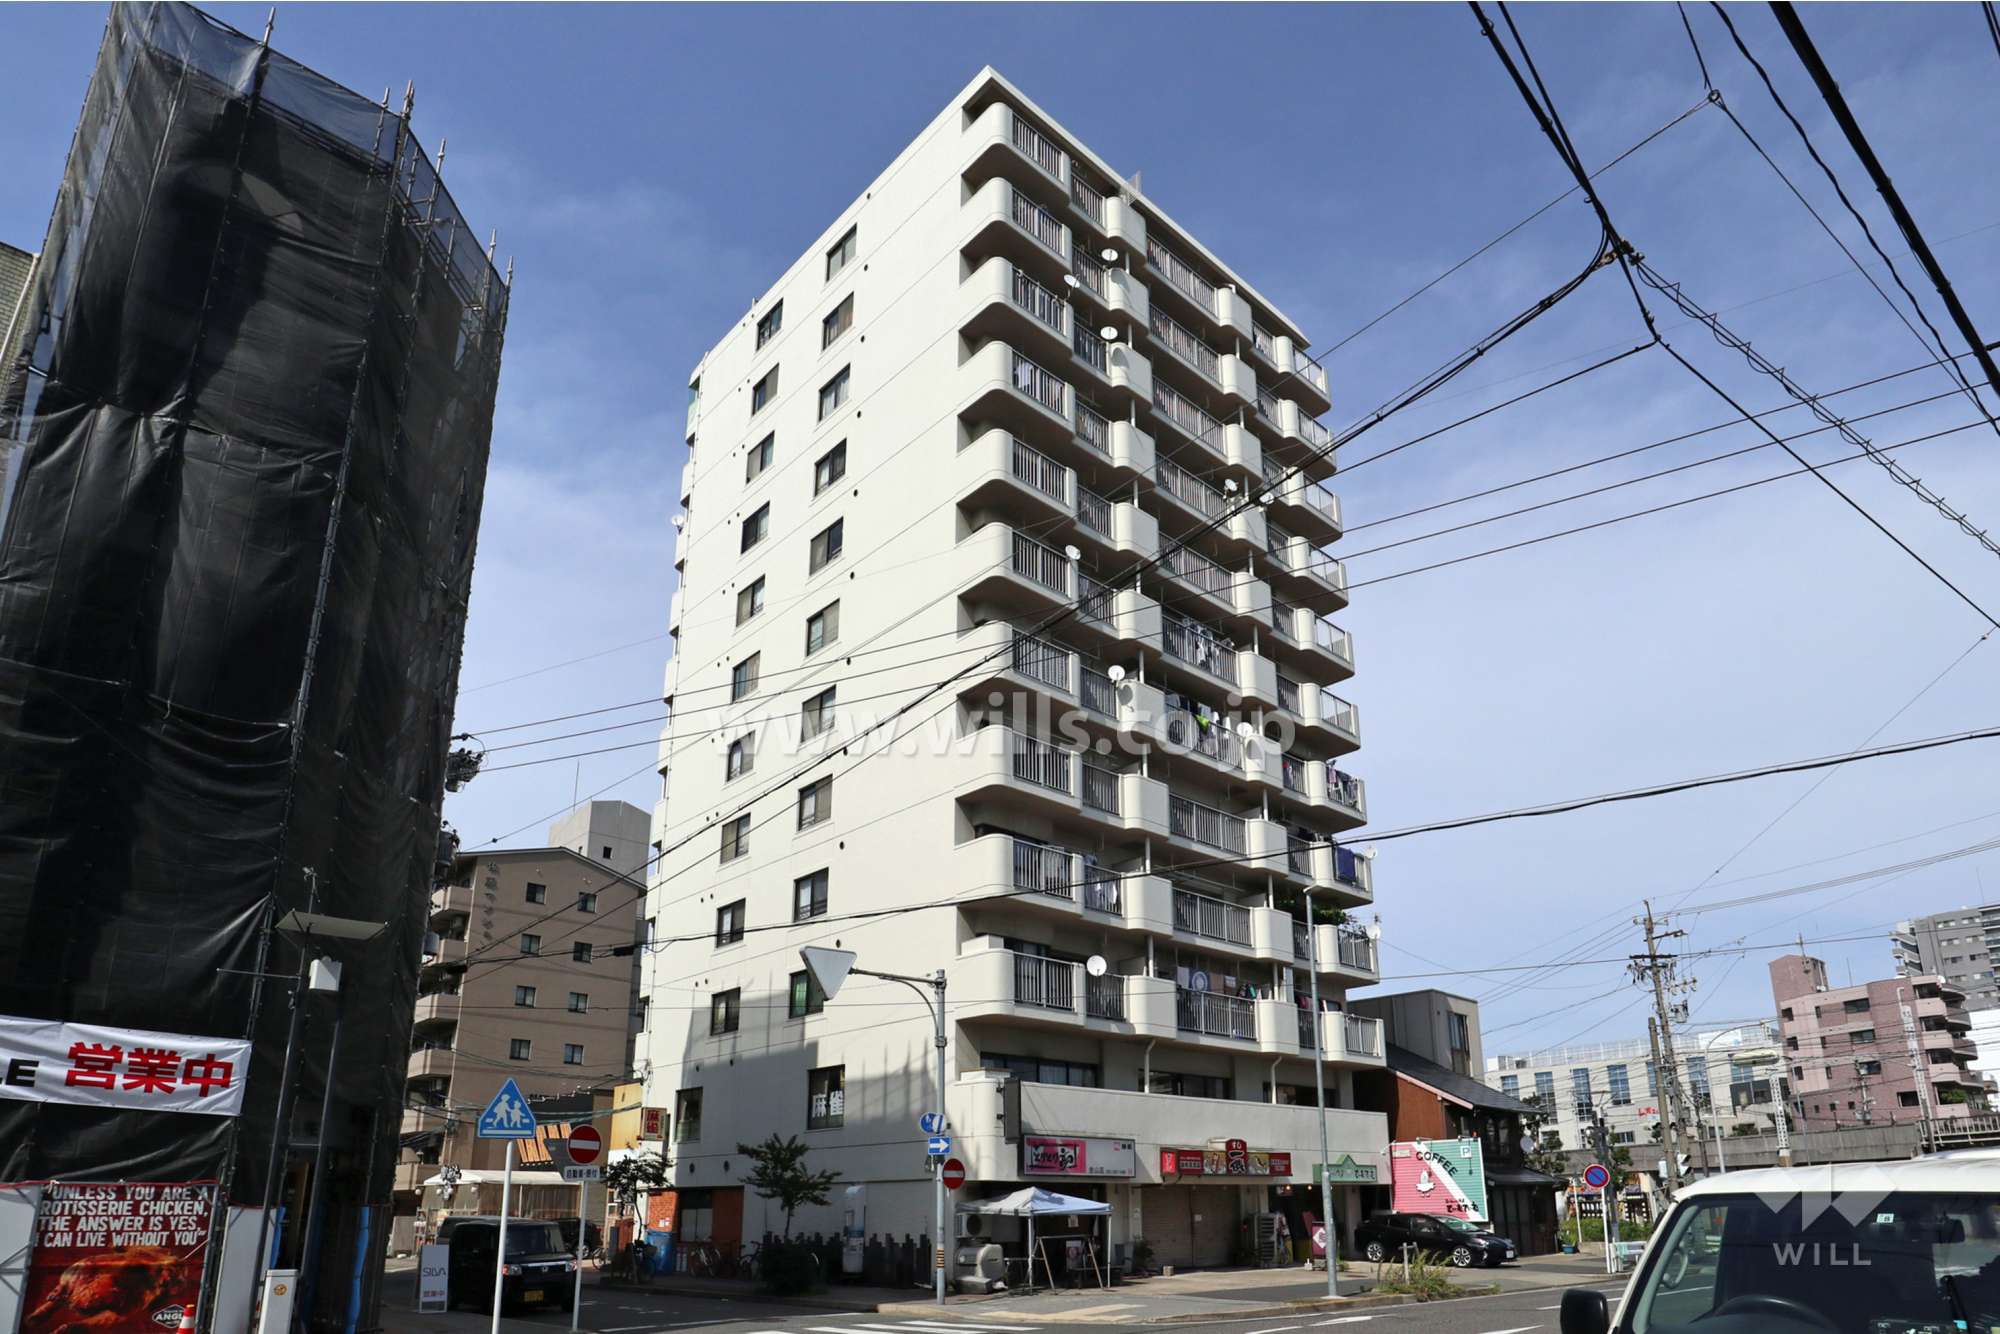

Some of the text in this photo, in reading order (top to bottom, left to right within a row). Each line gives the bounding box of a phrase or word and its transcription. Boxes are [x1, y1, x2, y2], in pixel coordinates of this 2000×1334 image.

[0, 1041, 234, 1098] E 営業中
[1462, 1147, 1471, 1157] P
[1416, 1151, 1459, 1177] COFFEE
[125, 1186, 156, 1201] YOU
[161, 1186, 192, 1201] ARE
[198, 1186, 208, 1200] A
[40, 1200, 209, 1217] ROTISSERIE CHICKEN,
[40, 1215, 201, 1233] THE ANSWER IS YES,
[44, 1232, 72, 1248] CAN
[76, 1231, 106, 1247] LIVE
[111, 1231, 170, 1247] WITHOUT
